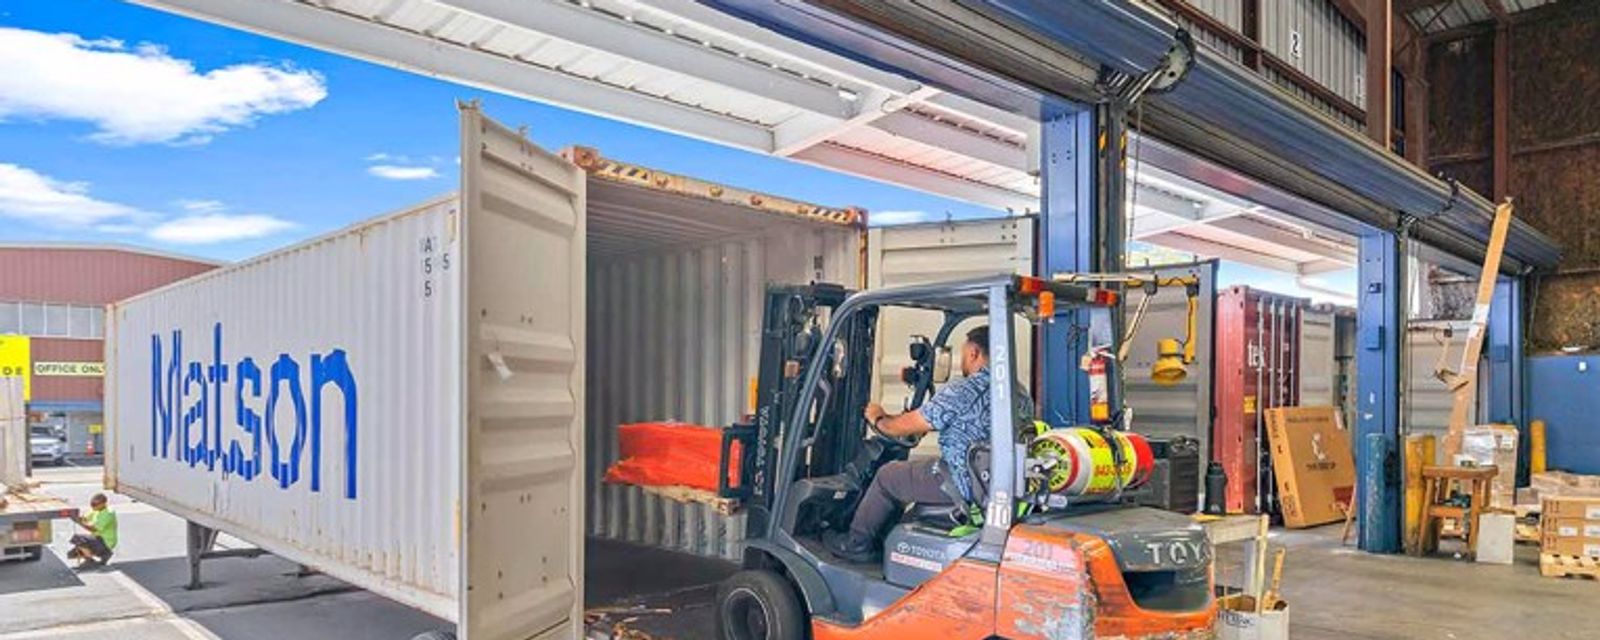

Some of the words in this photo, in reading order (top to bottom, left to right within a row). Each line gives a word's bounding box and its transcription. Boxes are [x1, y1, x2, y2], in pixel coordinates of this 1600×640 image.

[37, 364, 77, 374] OFFICE
[995, 345, 1006, 400] 201
[152, 322, 357, 499] Matson
